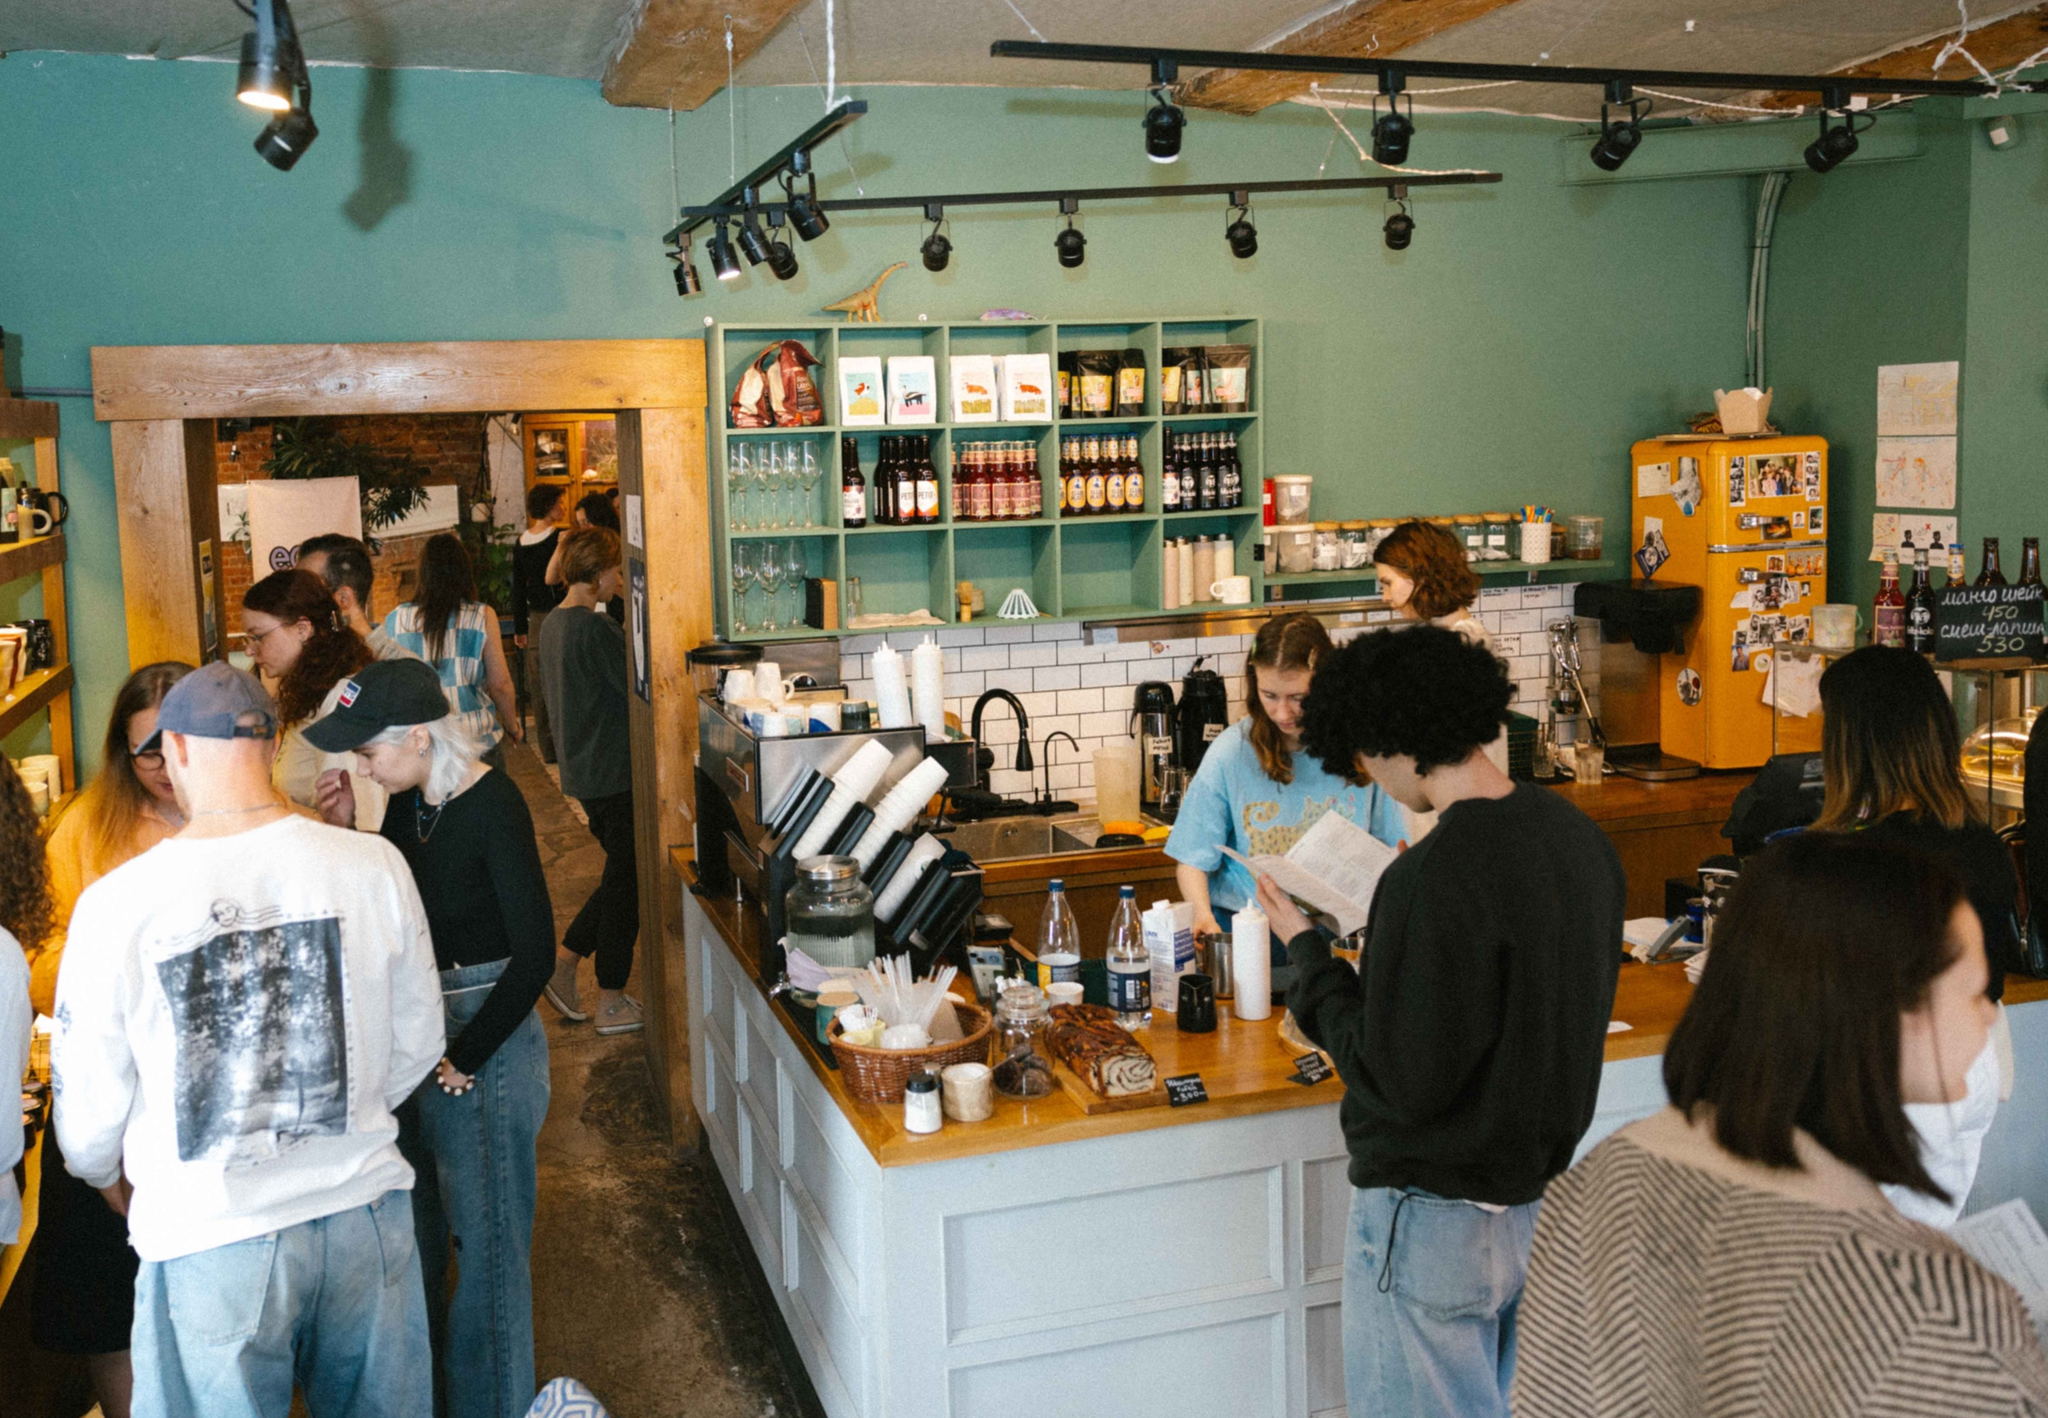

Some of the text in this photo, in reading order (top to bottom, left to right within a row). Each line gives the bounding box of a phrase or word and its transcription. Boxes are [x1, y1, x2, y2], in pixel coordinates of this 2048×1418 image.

[1941, 584, 2043, 606] манго шейк
[1982, 606, 2019, 622] 450
[1977, 635, 2025, 653] 530
